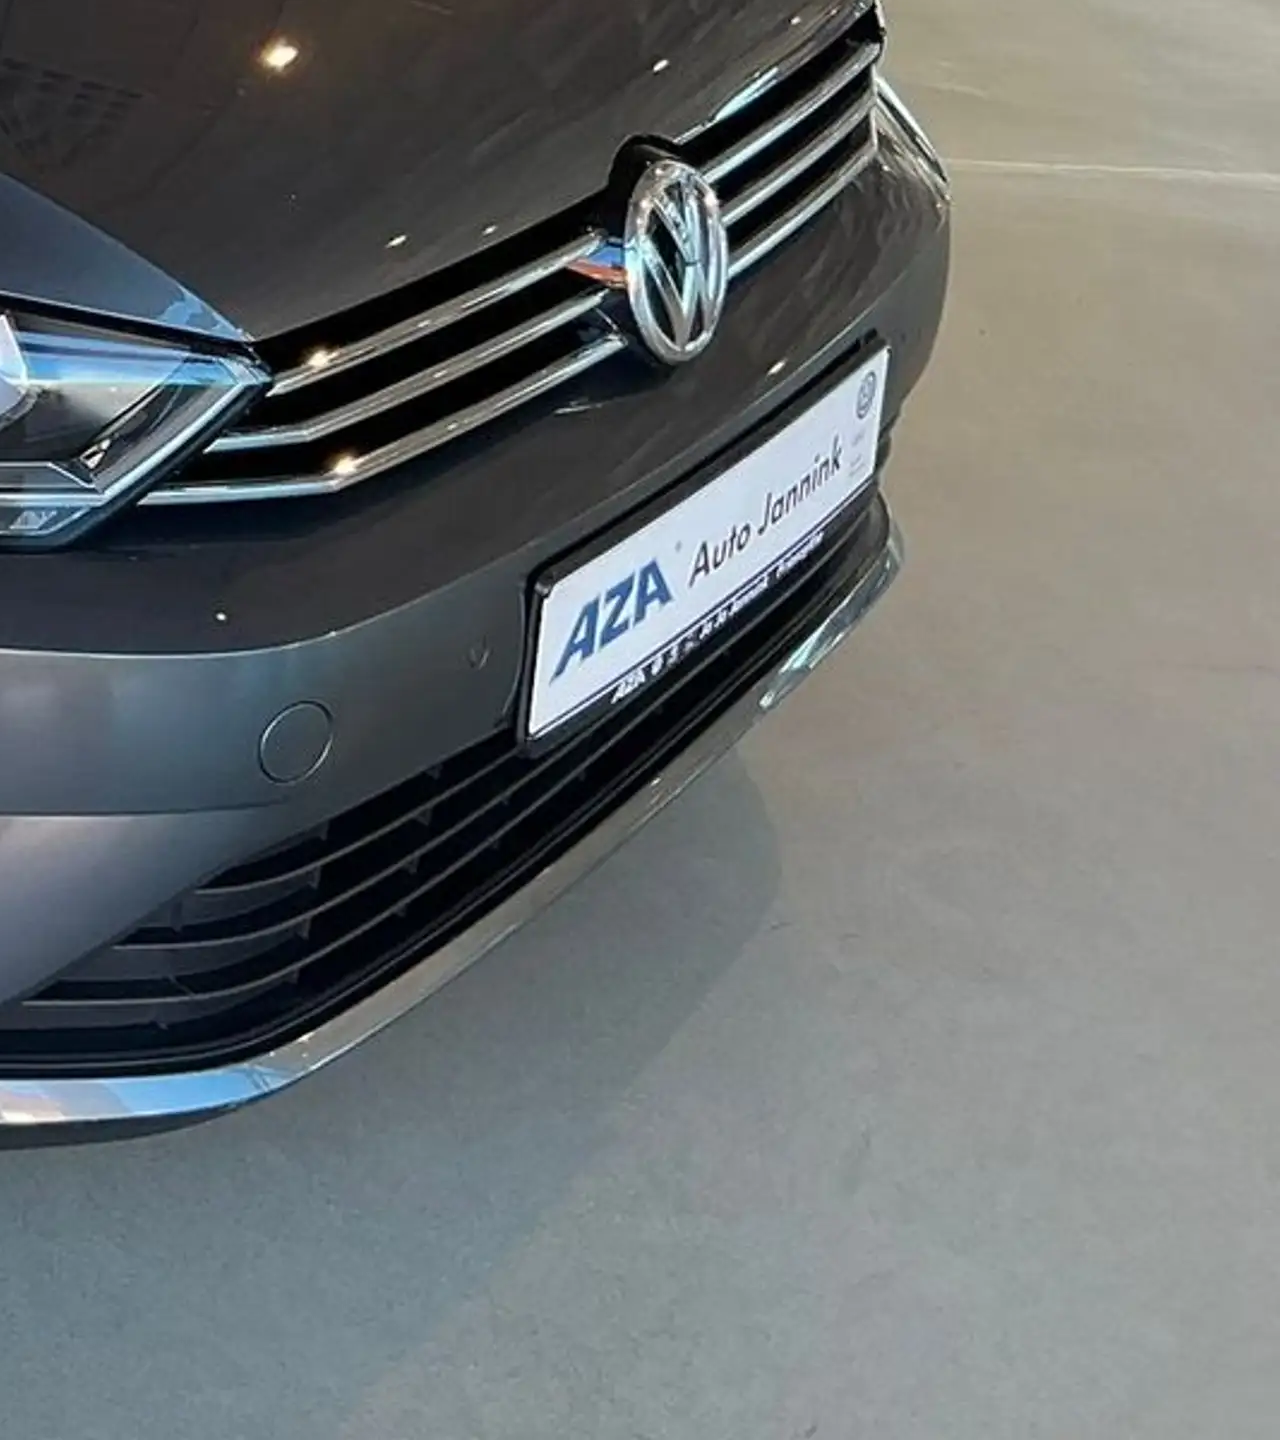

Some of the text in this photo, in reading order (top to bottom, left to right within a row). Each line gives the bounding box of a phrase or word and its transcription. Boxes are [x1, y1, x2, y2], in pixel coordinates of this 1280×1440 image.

[548, 556, 675, 685] AZA
[688, 523, 751, 589] Auto
[757, 433, 843, 536] Jannink
